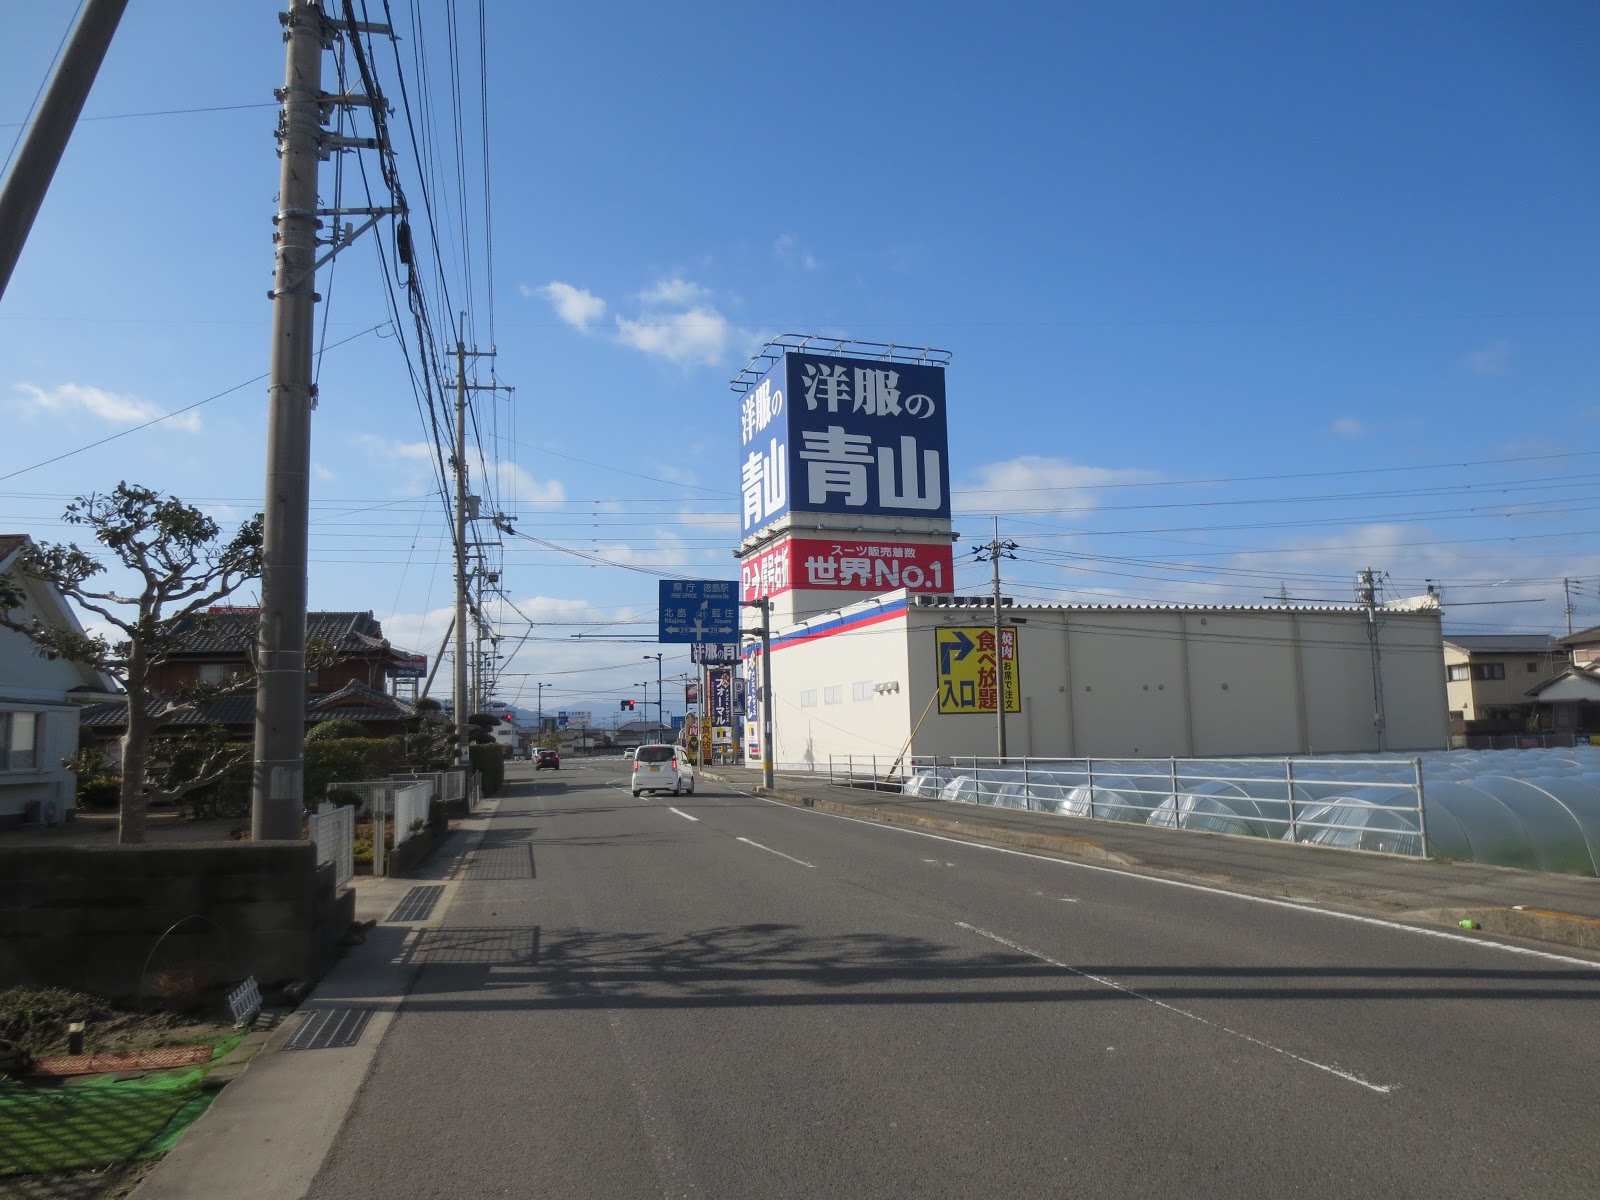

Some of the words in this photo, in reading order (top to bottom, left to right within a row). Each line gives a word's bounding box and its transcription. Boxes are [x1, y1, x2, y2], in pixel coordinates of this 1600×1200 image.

[801, 363, 936, 419] 洋服の
[741, 378, 783, 446] 洋服の
[799, 425, 942, 511] 青山
[741, 437, 786, 531] 青山
[831, 544, 916, 559] スーツ販売着数
[804, 555, 943, 588] 世界No.1
[673, 582, 696, 593] 県庁
[703, 583, 729, 593] 徳島駅
[664, 608, 687, 618] 北島
[712, 608, 734, 618] 藍住
[1001, 631, 1013, 659] 焼肉
[941, 679, 976, 708] 入口
[1003, 661, 1014, 709] お席で注文
